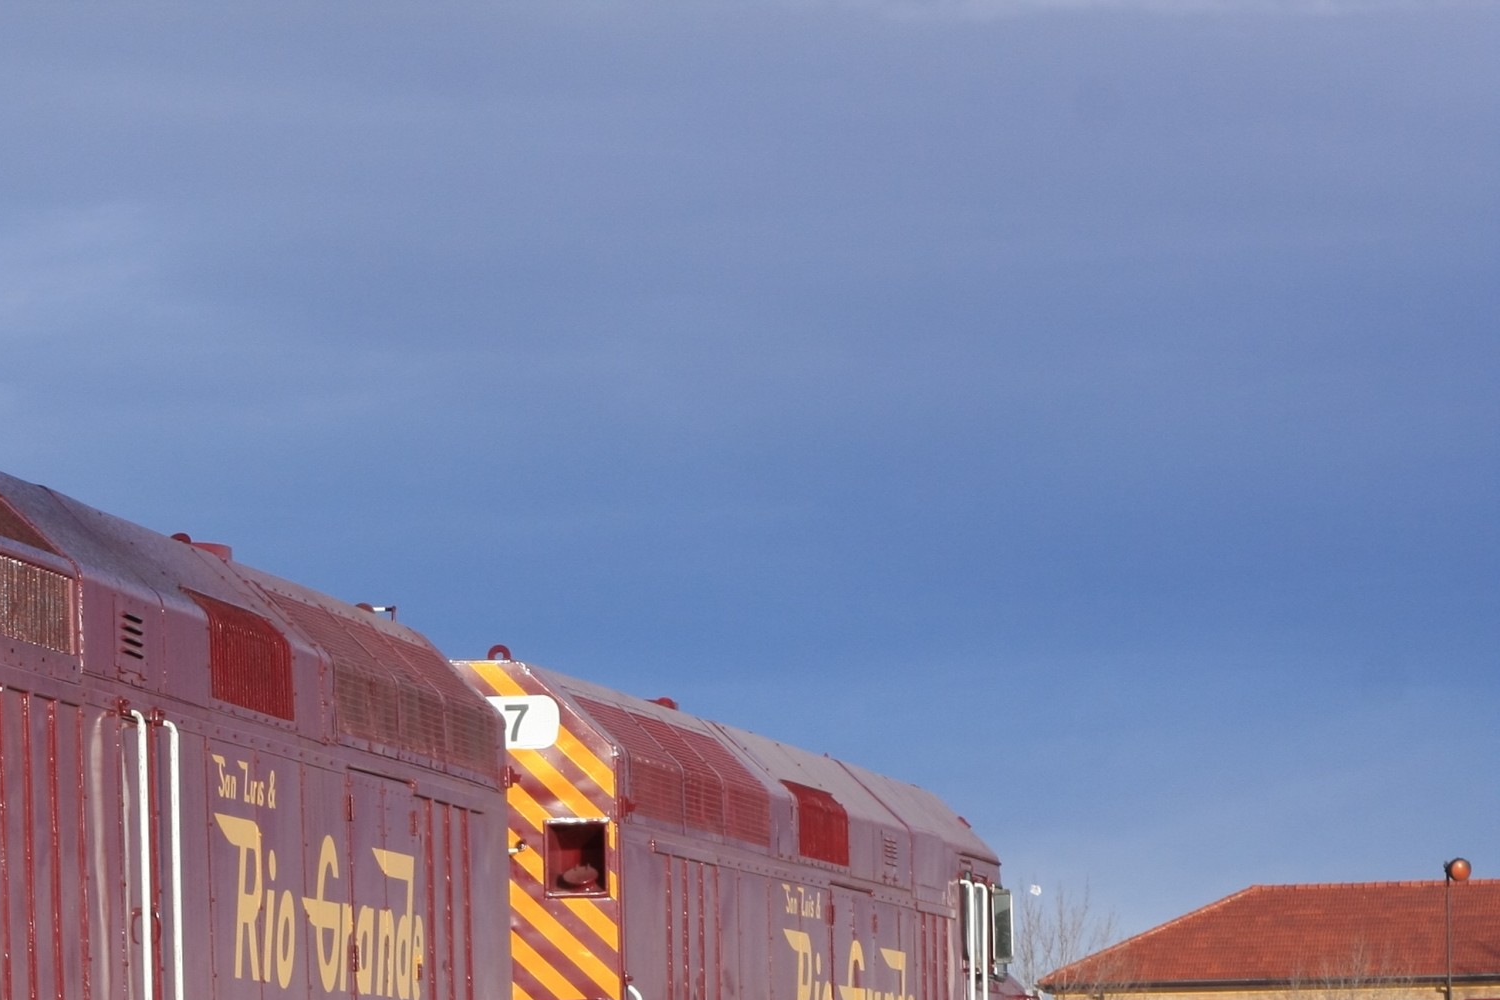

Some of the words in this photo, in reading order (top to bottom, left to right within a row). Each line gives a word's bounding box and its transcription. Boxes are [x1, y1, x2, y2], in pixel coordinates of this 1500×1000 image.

[504, 704, 529, 742] 7
[211, 754, 237, 800] San
[237, 759, 265, 807] Luis
[267, 770, 277, 810] &
[213, 812, 296, 990] Rio
[781, 883, 798, 915] San
[797, 886, 815, 918] Luis
[815, 891, 822, 920] &
